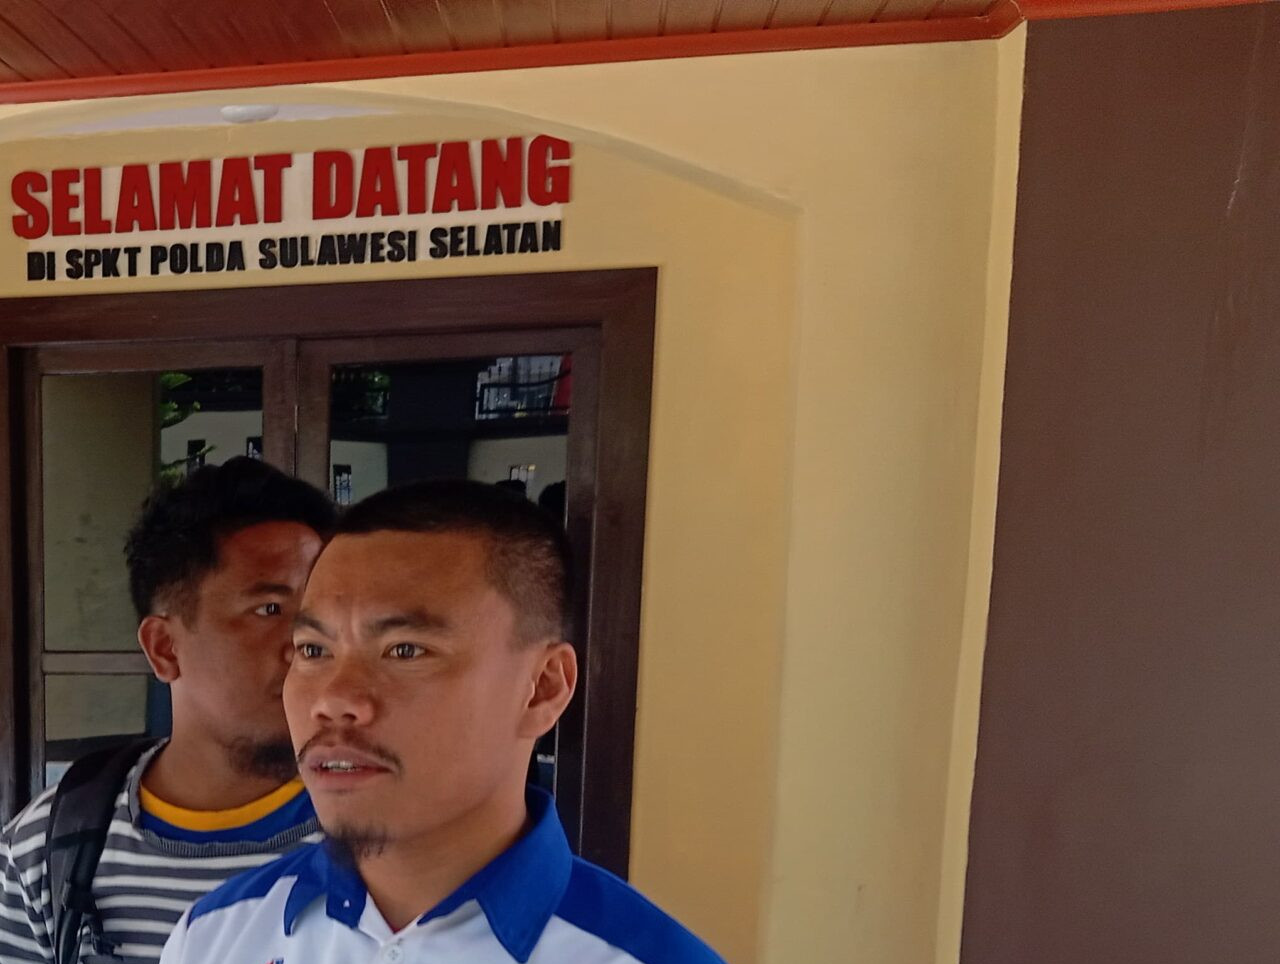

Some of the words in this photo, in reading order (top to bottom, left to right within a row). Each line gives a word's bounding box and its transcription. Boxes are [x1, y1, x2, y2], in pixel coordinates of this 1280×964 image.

[11, 153, 292, 239] SELAMAT
[312, 134, 572, 220] DATANG
[27, 251, 56, 281] DI
[65, 245, 141, 279] SPKT
[150, 241, 246, 275] POLDA
[258, 230, 417, 269] SULAWESI
[429, 220, 561, 258] SELATAN
